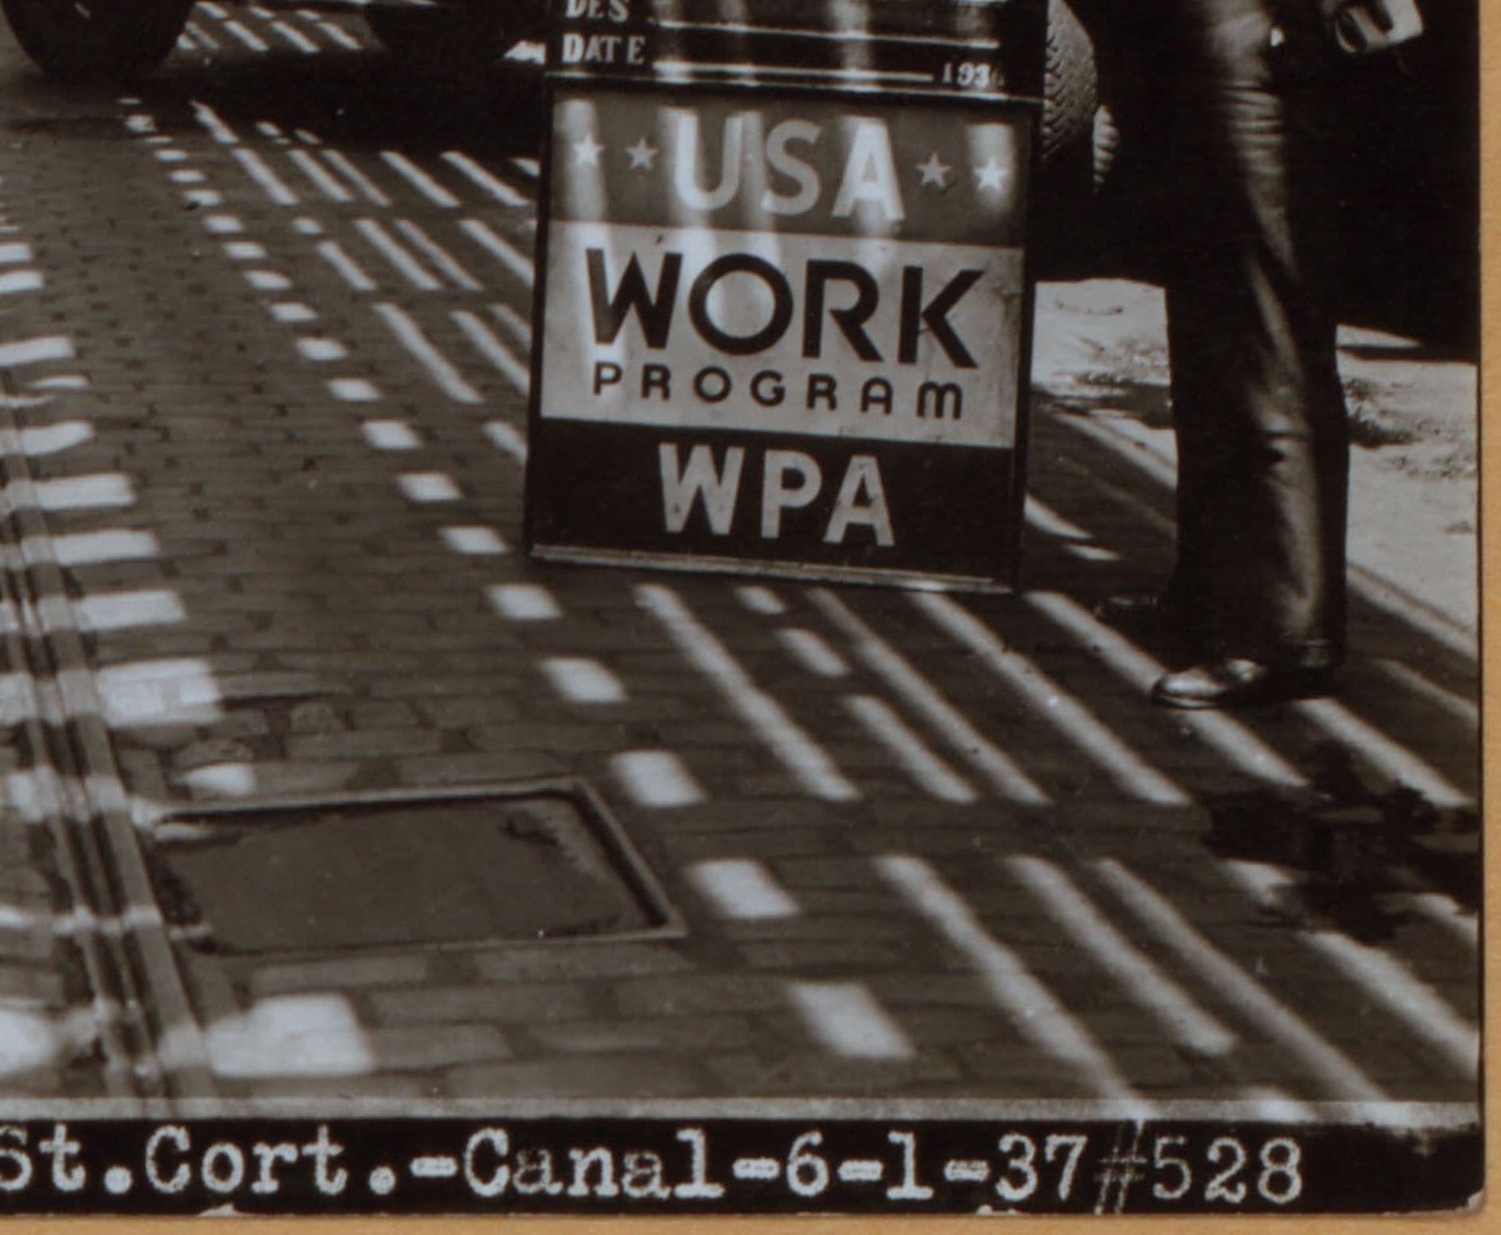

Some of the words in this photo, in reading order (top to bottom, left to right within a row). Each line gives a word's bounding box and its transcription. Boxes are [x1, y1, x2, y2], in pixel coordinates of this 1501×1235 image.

[562, 32, 647, 65] DATE
[670, 106, 904, 221] USA
[586, 248, 983, 369] WORK
[593, 361, 962, 420] PROGRAM
[659, 442, 896, 547] WPA
